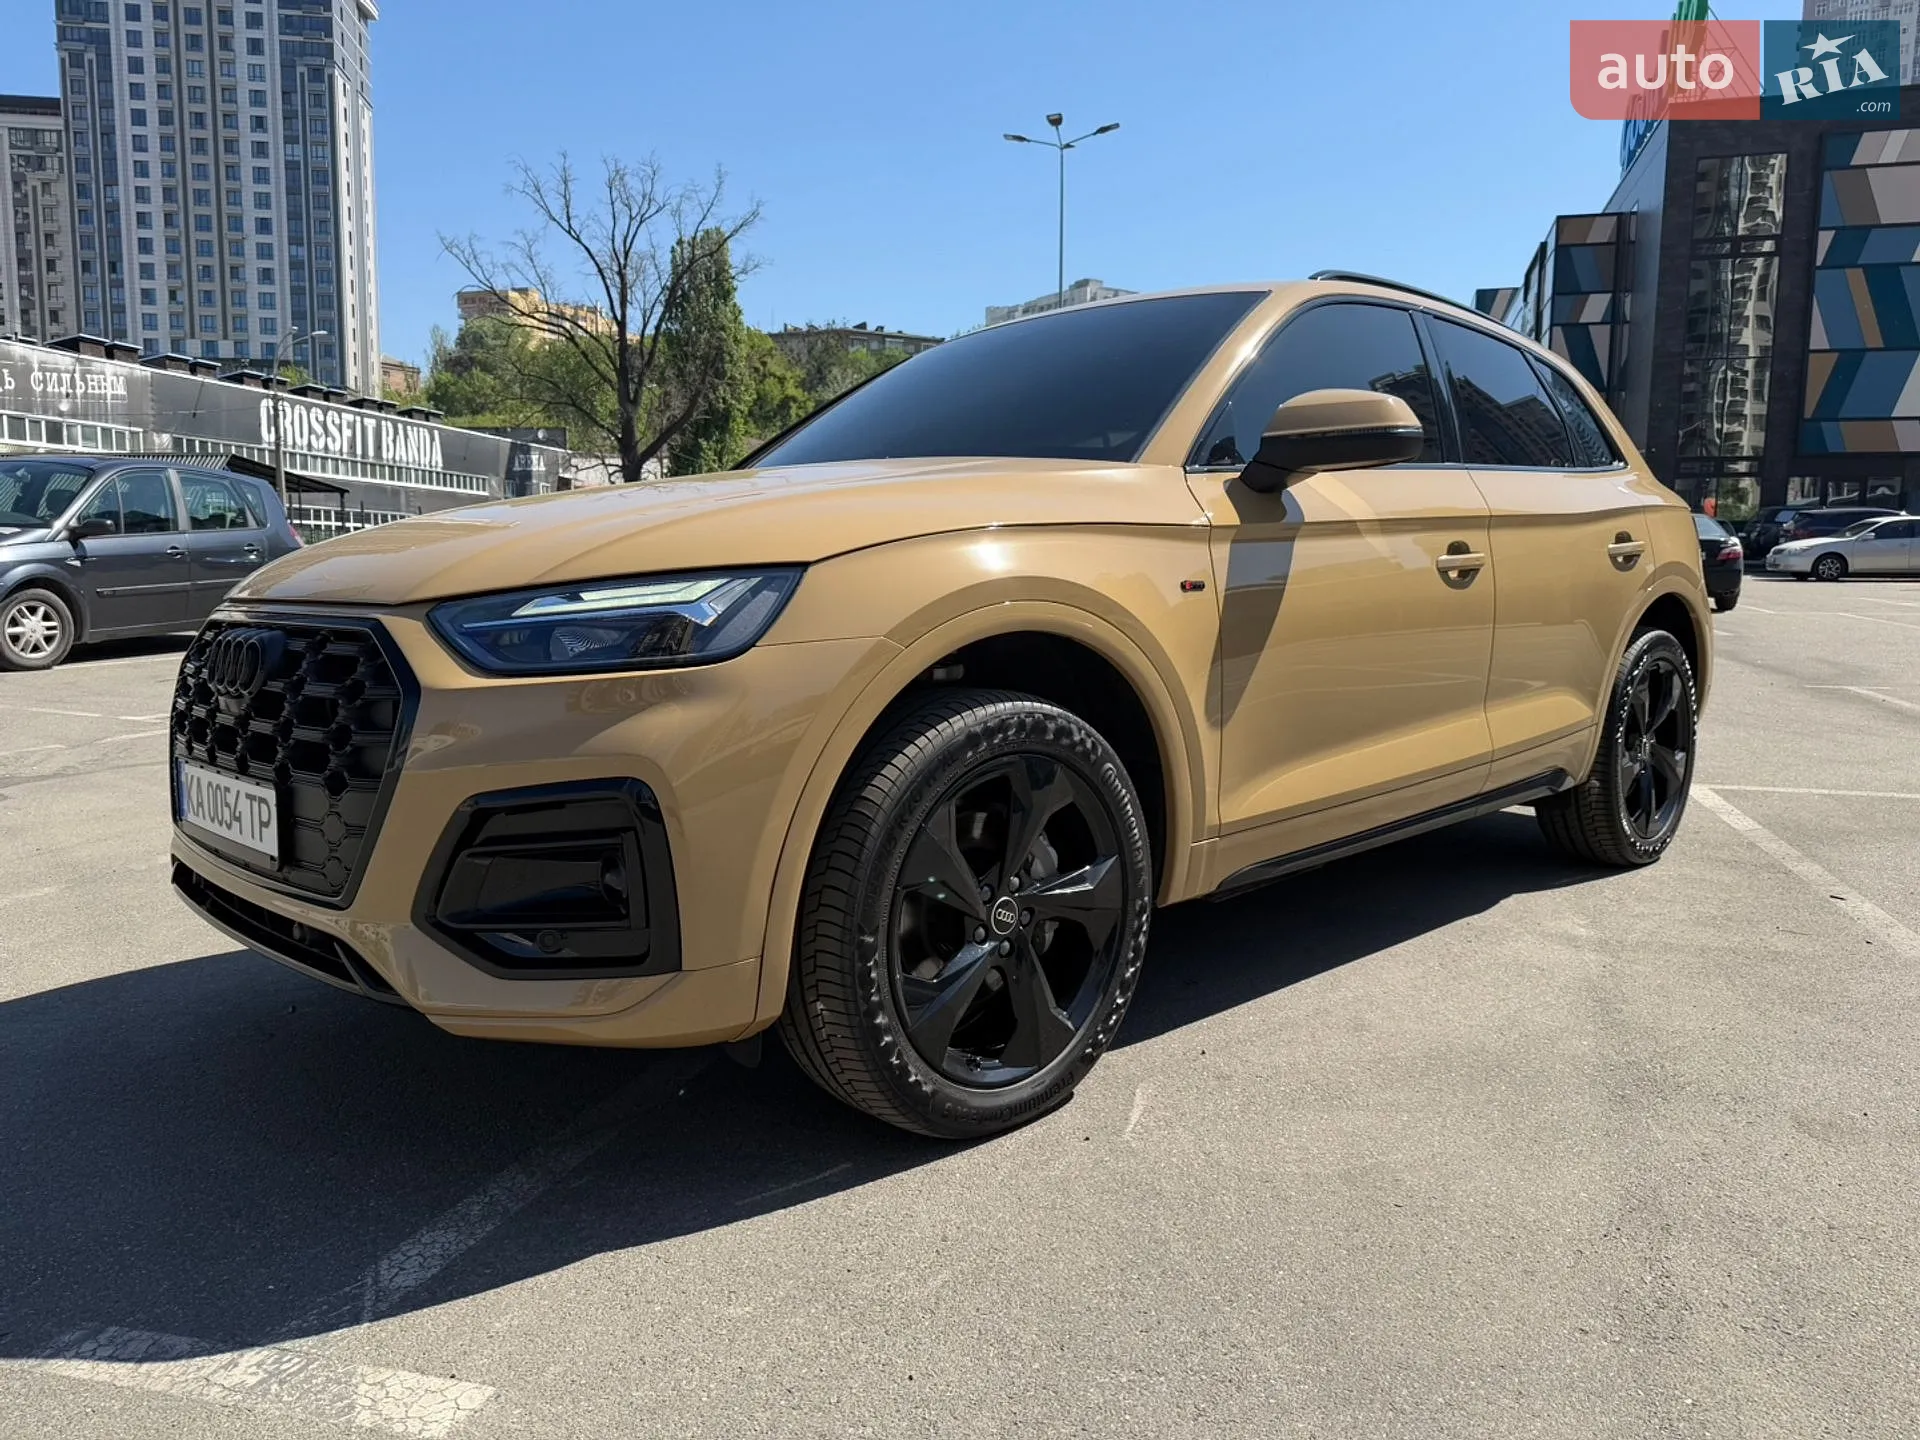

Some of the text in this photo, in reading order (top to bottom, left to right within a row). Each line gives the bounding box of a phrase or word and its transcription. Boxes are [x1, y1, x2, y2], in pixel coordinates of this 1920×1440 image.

[260, 398, 443, 469] CROSSFIT BANDA
[207, 781, 243, 836] 0054
